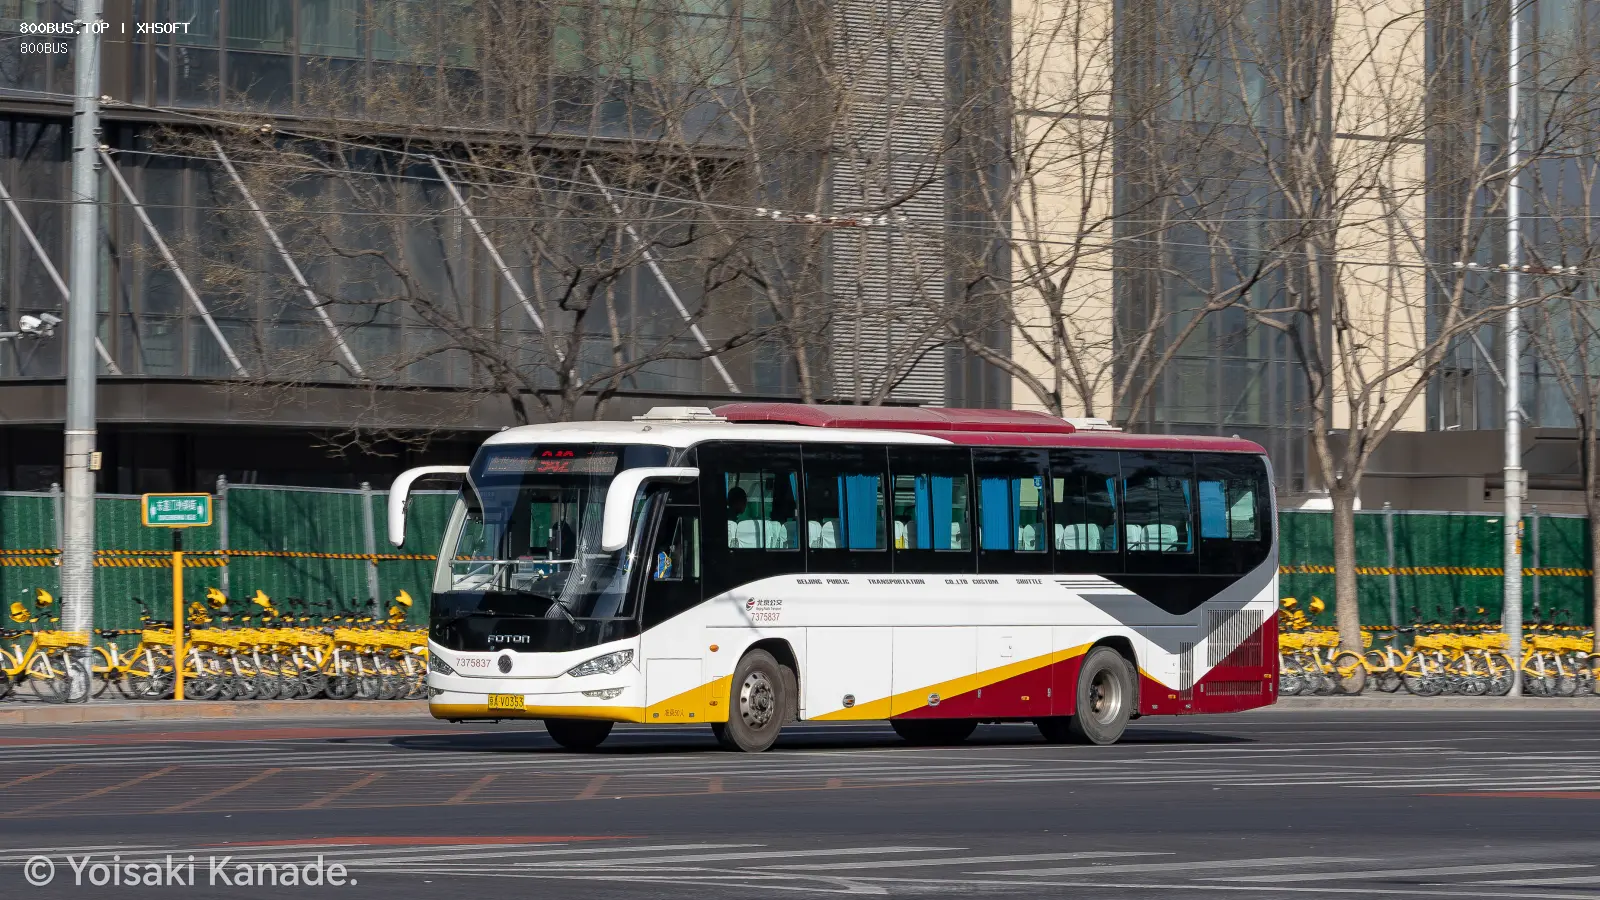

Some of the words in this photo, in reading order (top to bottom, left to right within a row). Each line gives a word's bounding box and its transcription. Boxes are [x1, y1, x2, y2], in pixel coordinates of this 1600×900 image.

[751, 612, 780, 622] 7375837
[487, 634, 530, 643] FOTON
[455, 657, 492, 668] 7375837
